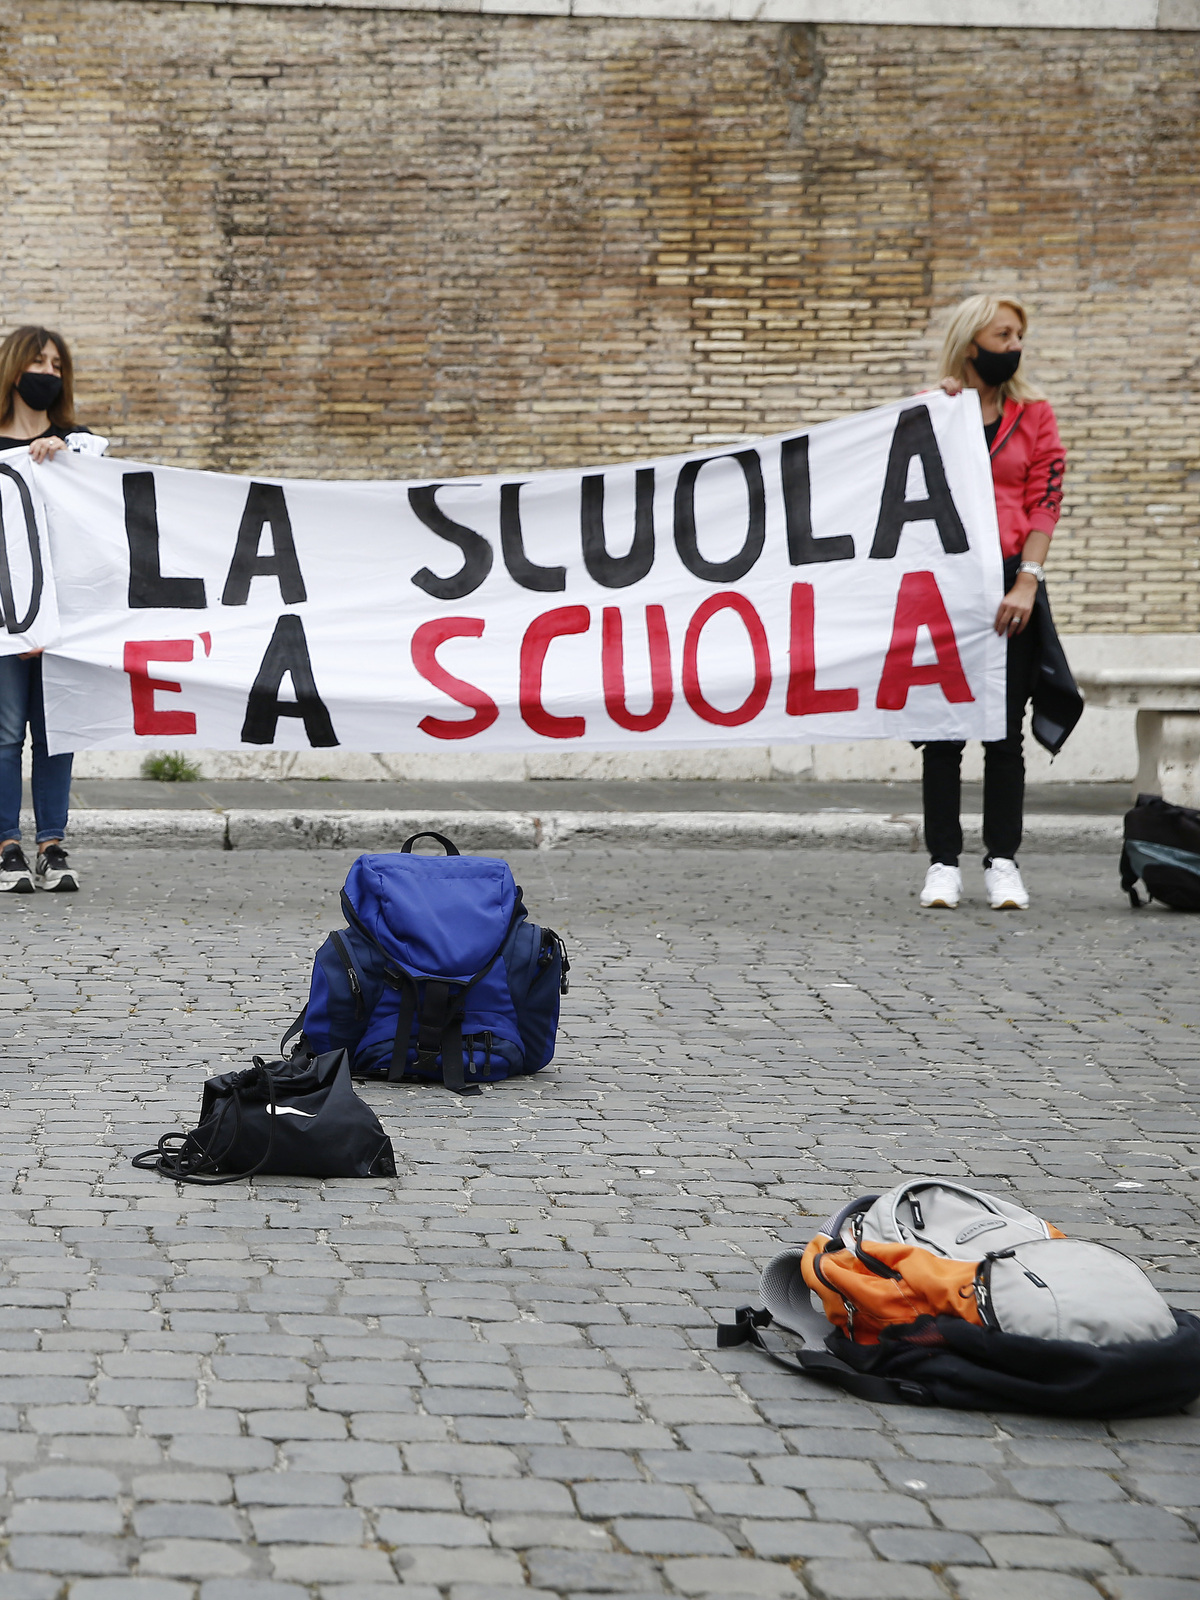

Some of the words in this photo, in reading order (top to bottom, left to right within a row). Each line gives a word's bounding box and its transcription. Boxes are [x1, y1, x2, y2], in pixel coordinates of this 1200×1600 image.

[122, 471, 307, 609] LA
[407, 404, 970, 600] SCUOLA
[241, 614, 341, 747] A
[410, 571, 975, 740] SCUOLA
